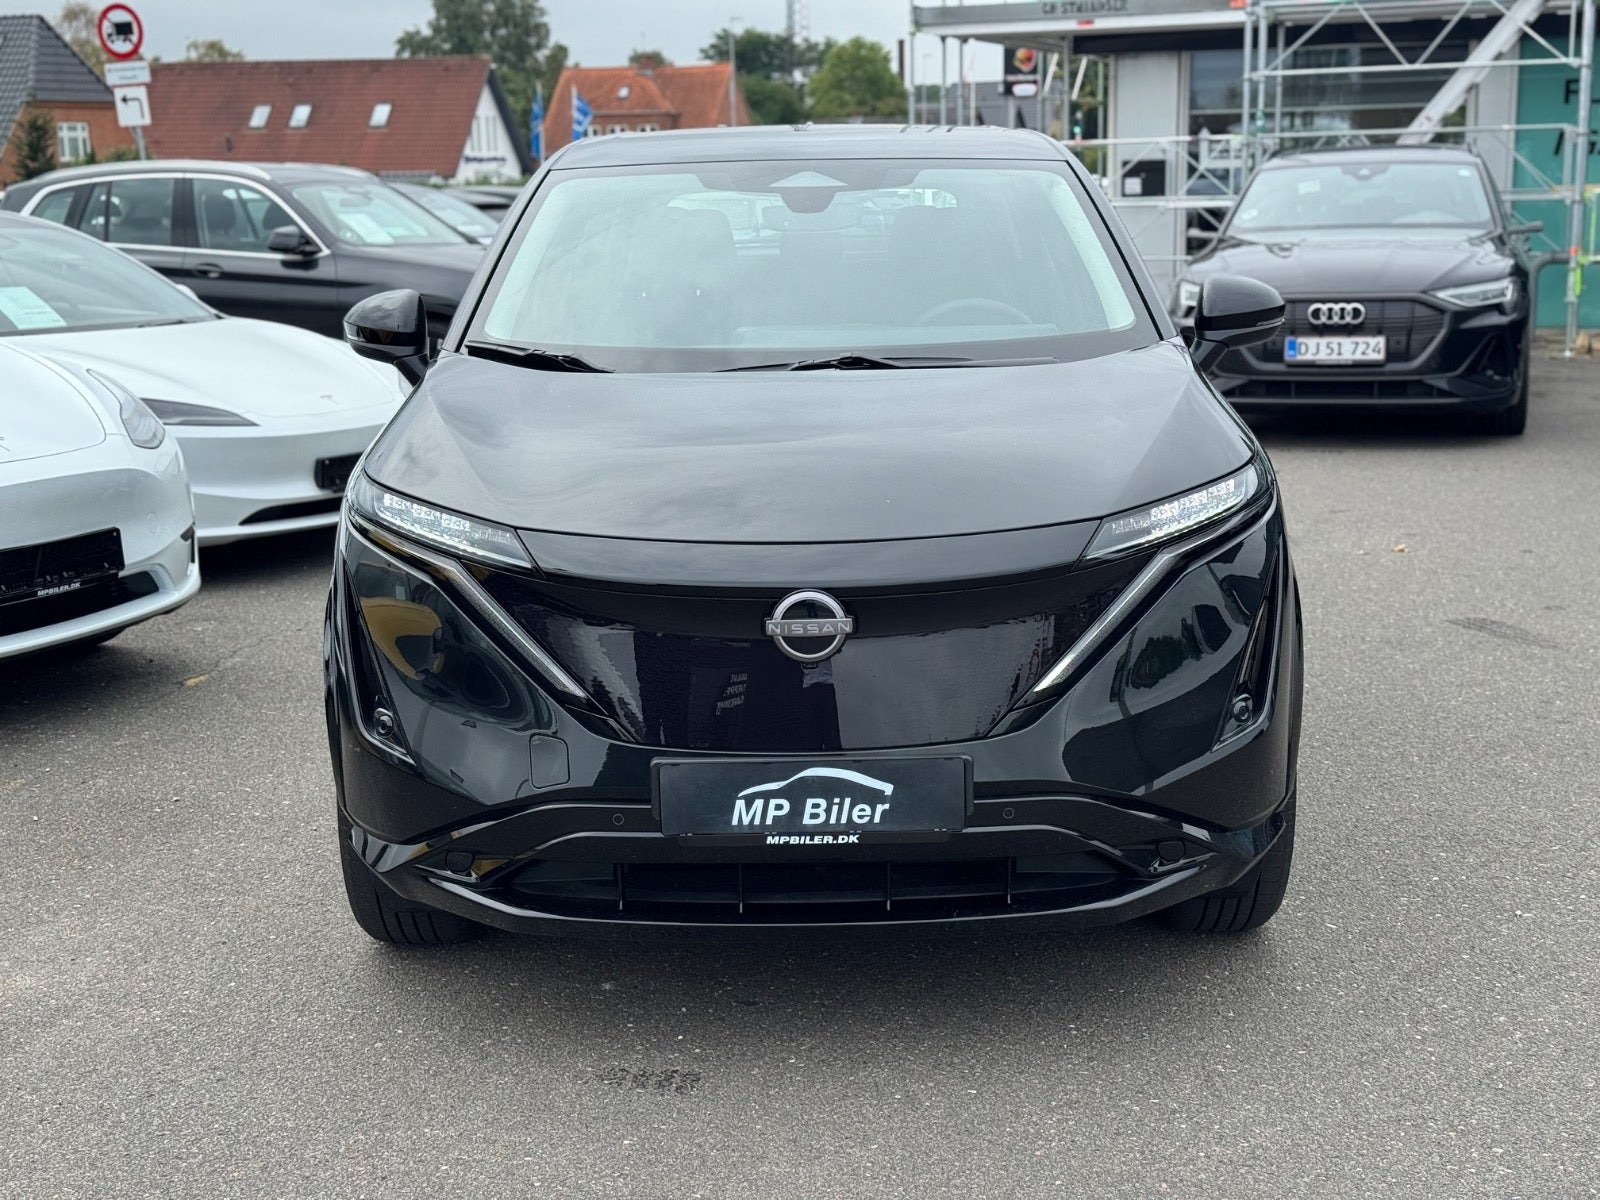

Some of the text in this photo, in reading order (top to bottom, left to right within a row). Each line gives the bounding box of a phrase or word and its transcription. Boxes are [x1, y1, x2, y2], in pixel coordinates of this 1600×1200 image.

[1298, 341, 1381, 356] DJ 51 724
[767, 622, 851, 635] NISSAN
[731, 798, 890, 826] MP Biler
[766, 834, 860, 845] MPBILER.DK
